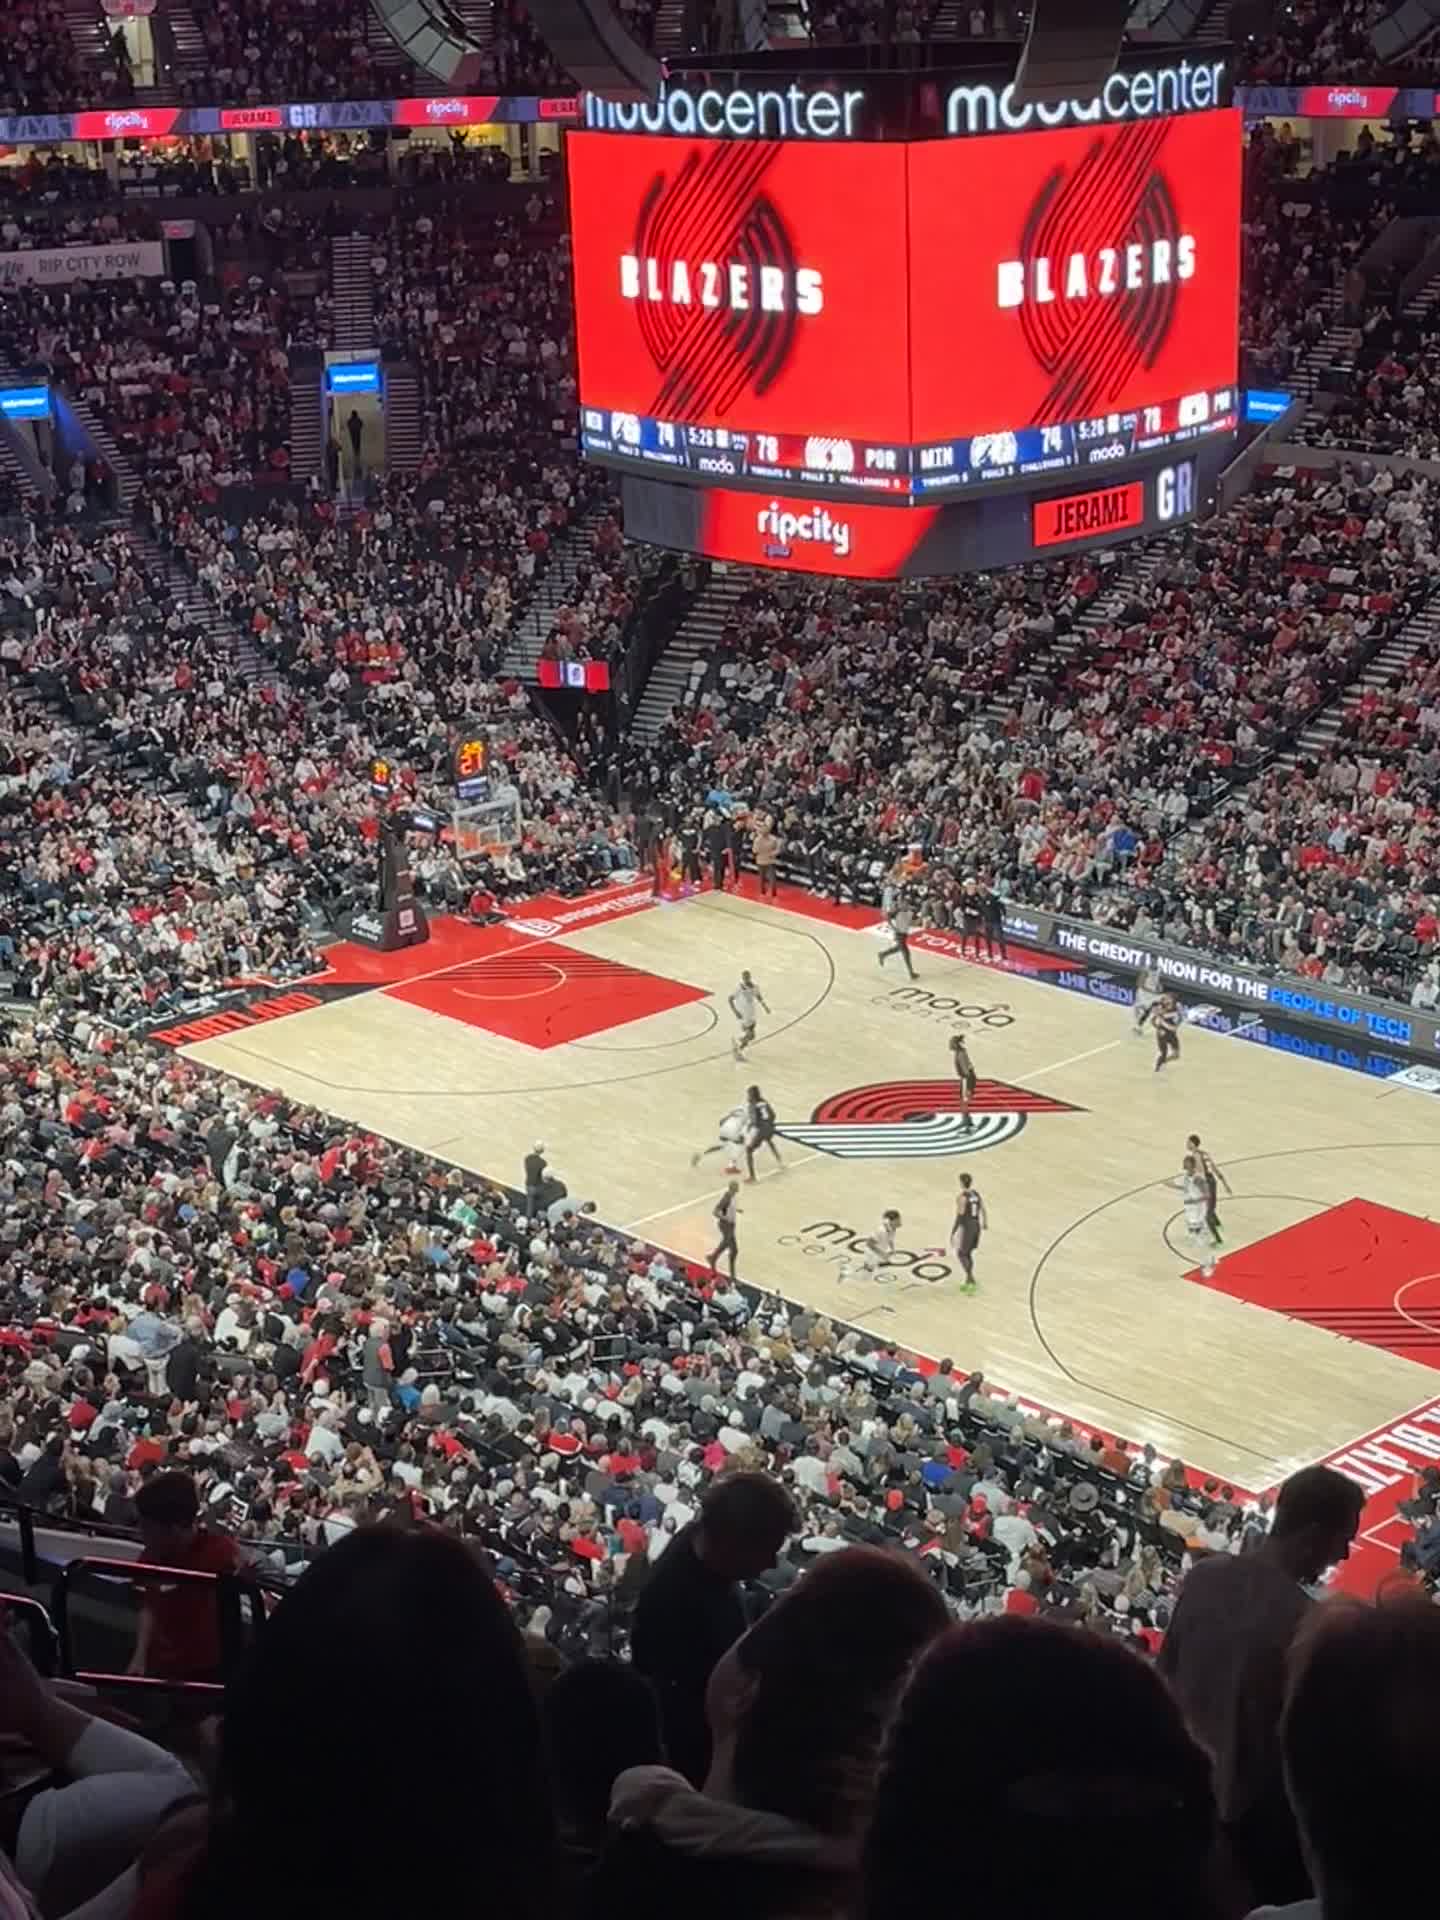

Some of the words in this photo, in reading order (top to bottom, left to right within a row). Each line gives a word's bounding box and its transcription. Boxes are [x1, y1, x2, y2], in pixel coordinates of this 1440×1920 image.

[39, 258, 63, 273] RIP
[66, 256, 100, 273] CITY
[105, 252, 141, 269] ROW
[620, 254, 824, 314] BLAZERS
[997, 235, 1196, 309] BLAZERS
[756, 434, 779, 463] 78
[865, 447, 896, 470] POR
[1040, 425, 1062, 454] 74
[757, 501, 849, 556] ripcity
[1053, 490, 1129, 537] JERAMI
[1057, 929, 1087, 951] THE
[1088, 940, 1145, 966] CREDIT
[1200, 968, 1232, 992] FOR
[1235, 977, 1268, 1000] THE
[1270, 987, 1335, 1019] PEOPLE
[1337, 1006, 1360, 1025] OF
[1366, 1012, 1411, 1038] TECH
[778, 1235, 925, 1291] cener
